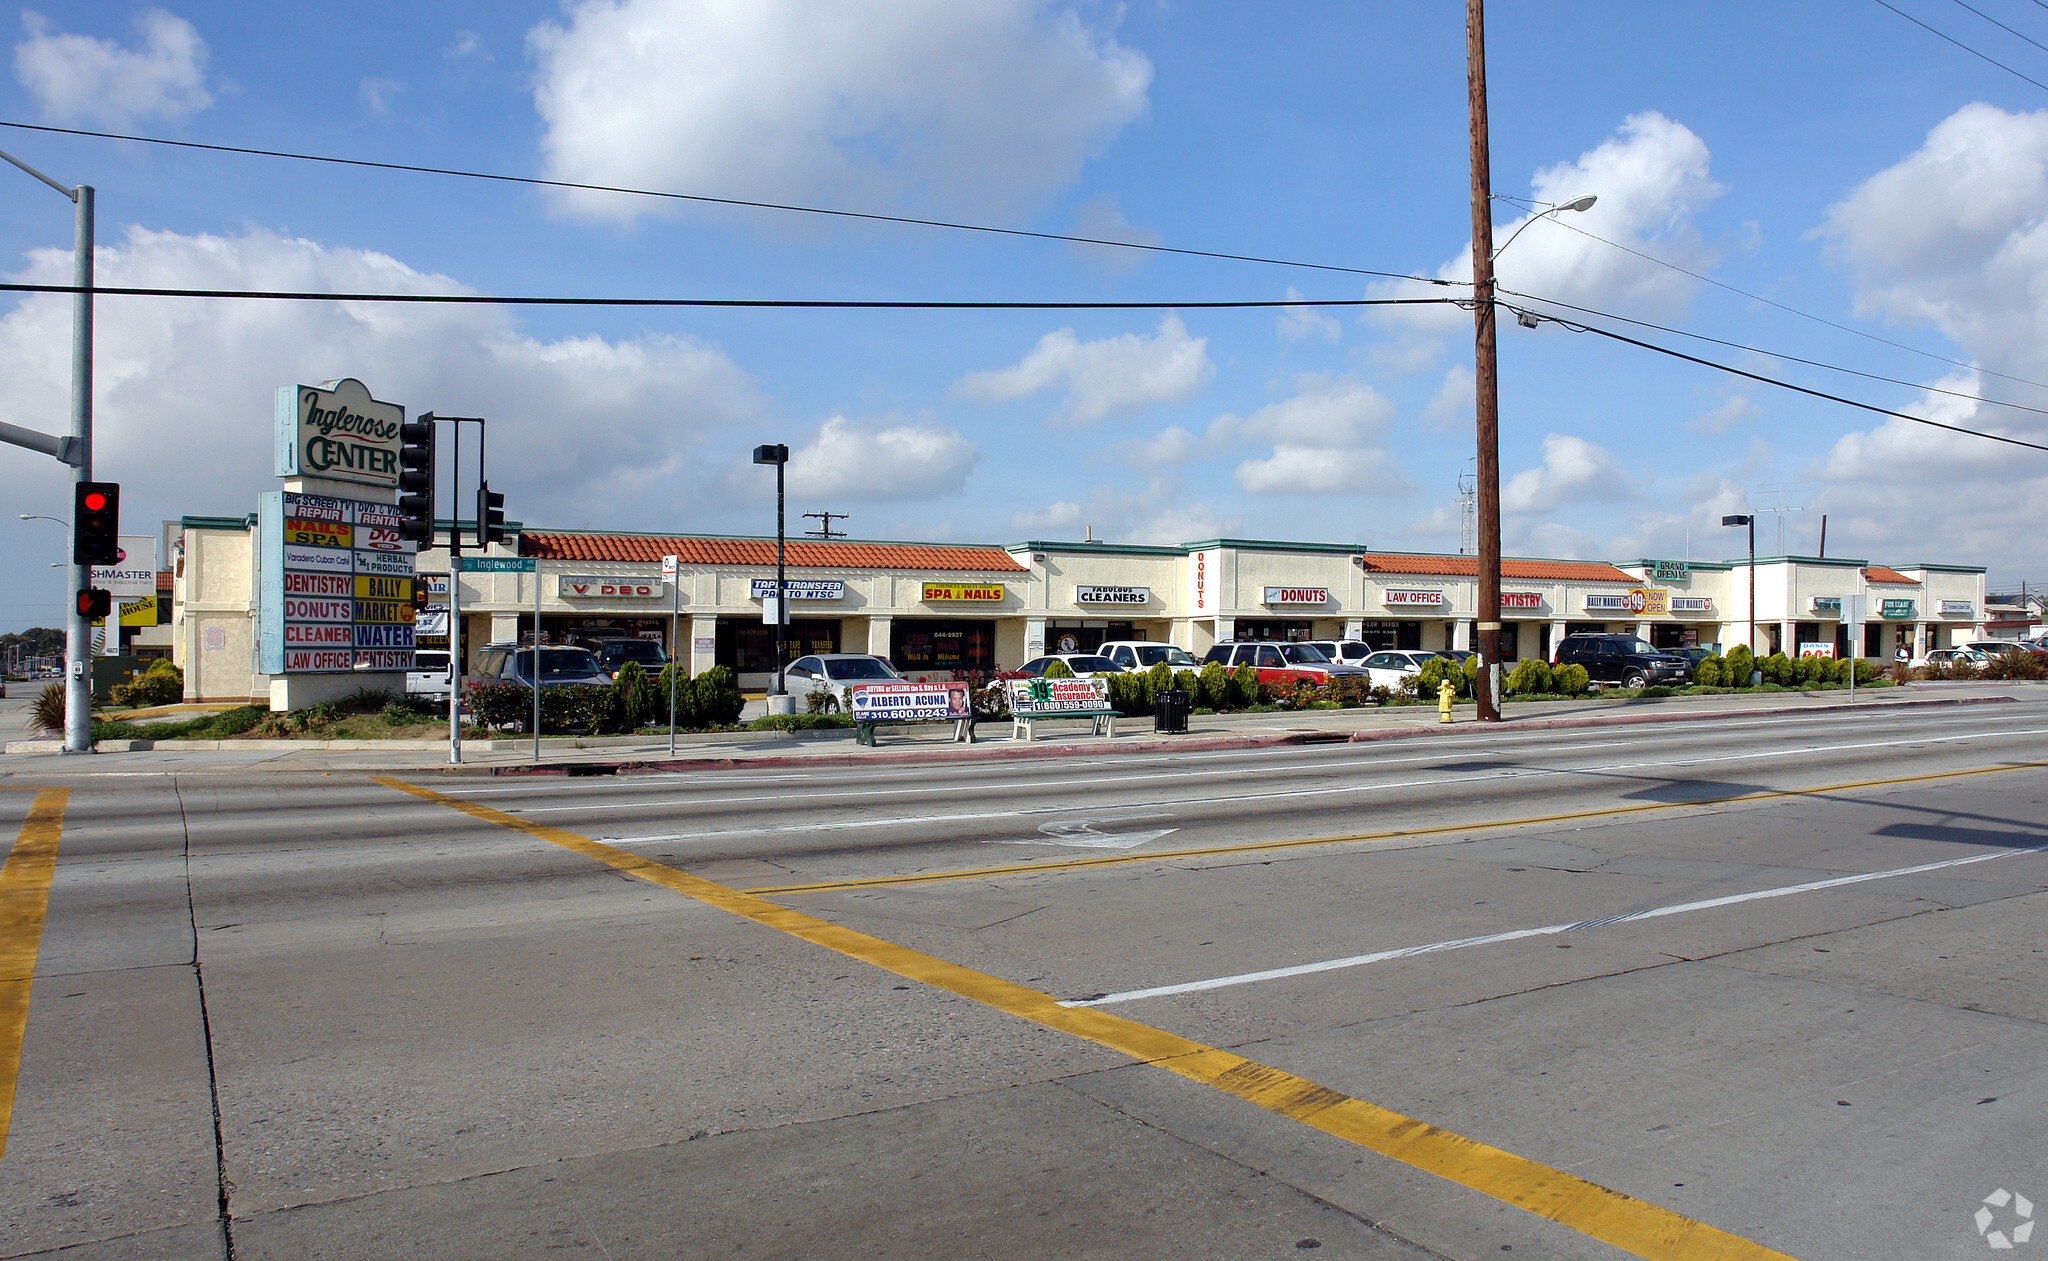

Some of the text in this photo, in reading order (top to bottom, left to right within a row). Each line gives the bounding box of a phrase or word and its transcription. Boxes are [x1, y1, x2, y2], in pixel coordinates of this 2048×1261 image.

[304, 391, 398, 439] Inglerose
[306, 436, 396, 474] CENTER
[285, 494, 351, 511] BIG SCREEN TV
[298, 507, 340, 520] REPAIR
[358, 502, 375, 514] DVD
[387, 506, 401, 517] VID
[362, 513, 405, 527] RENTAL
[287, 520, 349, 535] NAILS
[295, 532, 341, 546] SPA
[369, 528, 400, 542] DVD
[287, 553, 350, 565] Varadero Cuban Café
[376, 554, 408, 564] HERBAL
[477, 559, 522, 571] Inglewood
[371, 563, 413, 573] PRODUCTS
[1660, 562, 1684, 570] GRAND
[91, 569, 152, 579] SHMASTER
[1197, 553, 1205, 608] DONUTS
[1657, 570, 1687, 579] OPENING
[285, 574, 351, 594] DENTISTRY
[369, 577, 402, 597] BALLY
[428, 583, 446, 592] AIR
[787, 581, 842, 590] TRANSFER
[925, 589, 1001, 599] SPA & NAILS
[1081, 593, 1145, 603] CLEANERS
[1281, 589, 1326, 602] DONUTS
[1387, 592, 1441, 603] LAW OFFICE
[1500, 594, 1541, 607] ENTISTRY
[1648, 592, 1664, 601] NOW
[1603, 597, 1622, 607] MARKET
[1647, 603, 1666, 613] OPEN
[1686, 599, 1703, 609] MARKET
[119, 600, 156, 618] EHOUSE
[285, 601, 351, 619] DONUTS
[355, 602, 399, 621] MARKET
[285, 626, 351, 642] CLEANER
[356, 625, 413, 646] WATER
[286, 652, 350, 669] LAW OFFICE
[354, 651, 414, 668] DENTISTRY
[1032, 682, 1048, 699] 19
[1053, 683, 1091, 692] Academy
[871, 695, 946, 707] ALBERTO ACUNA
[1053, 692, 1096, 700] Insurance
[1036, 700, 1103, 710] 1(800)559-0090
[871, 708, 948, 719] 310.600.0243
